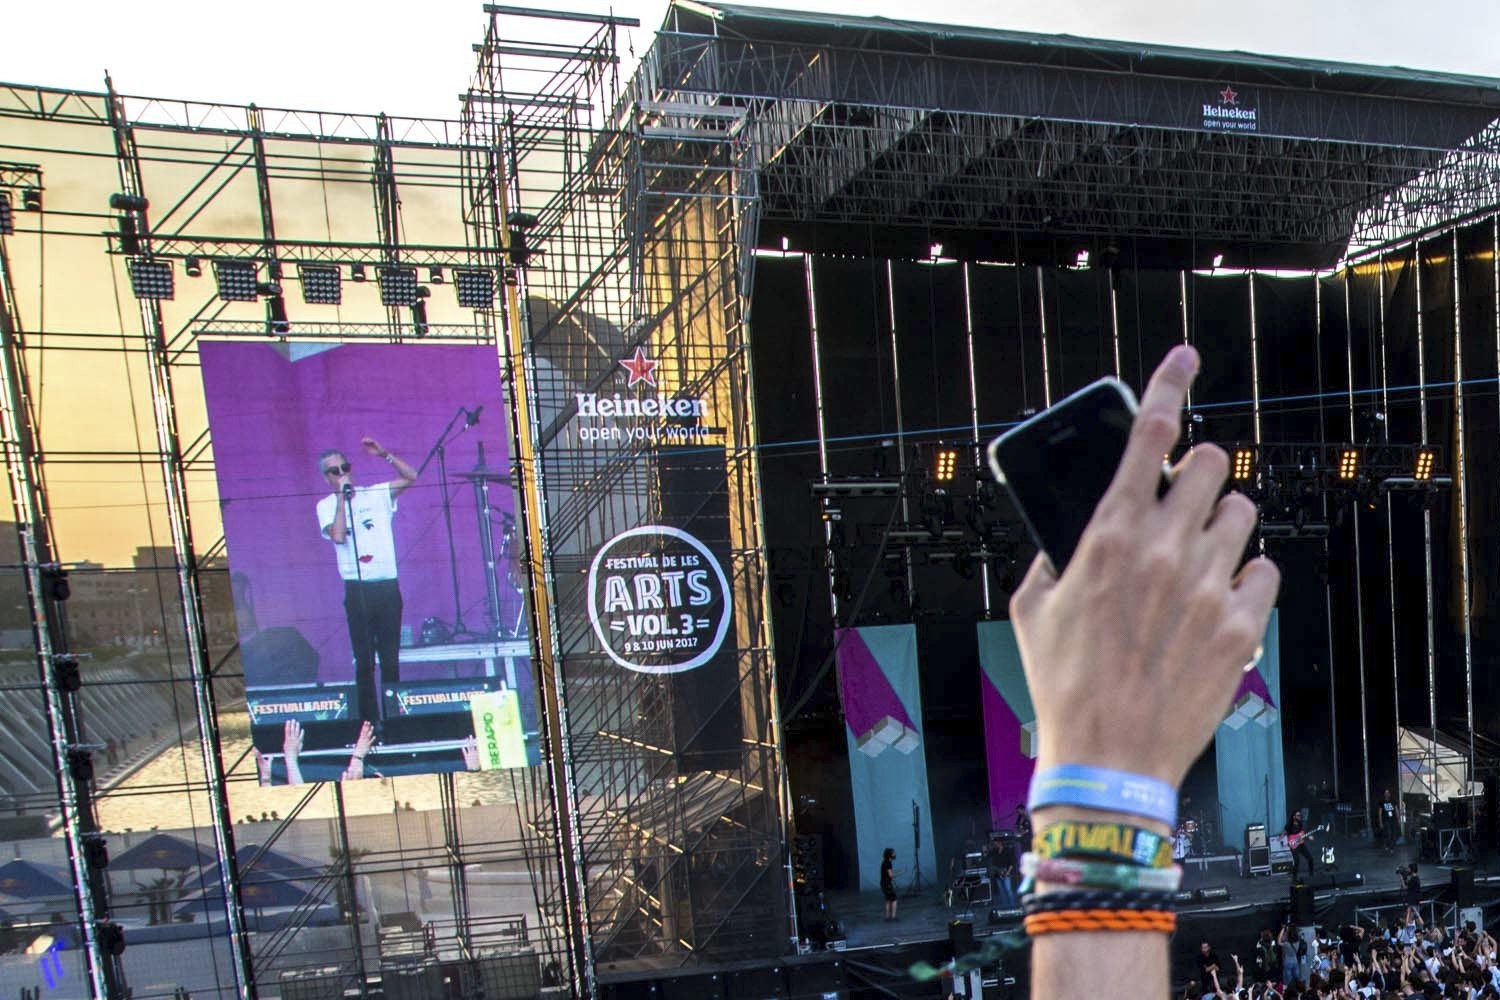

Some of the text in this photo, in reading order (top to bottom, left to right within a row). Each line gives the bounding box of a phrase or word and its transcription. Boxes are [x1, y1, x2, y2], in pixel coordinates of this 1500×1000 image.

[1203, 105, 1256, 119] Heineken
[1203, 120, 1256, 130] open your world
[575, 393, 709, 417] Heineken
[579, 424, 710, 443] open your world
[607, 555, 699, 569] FESTIVAL DE LES
[604, 569, 712, 613] ARTS
[627, 614, 695, 636] VOL. 3
[624, 637, 698, 652] 9 & 10 JUN 2017
[404, 692, 451, 705] FESTIVAL
[254, 702, 303, 715] FESTIVAL
[312, 700, 341, 711] ARTS
